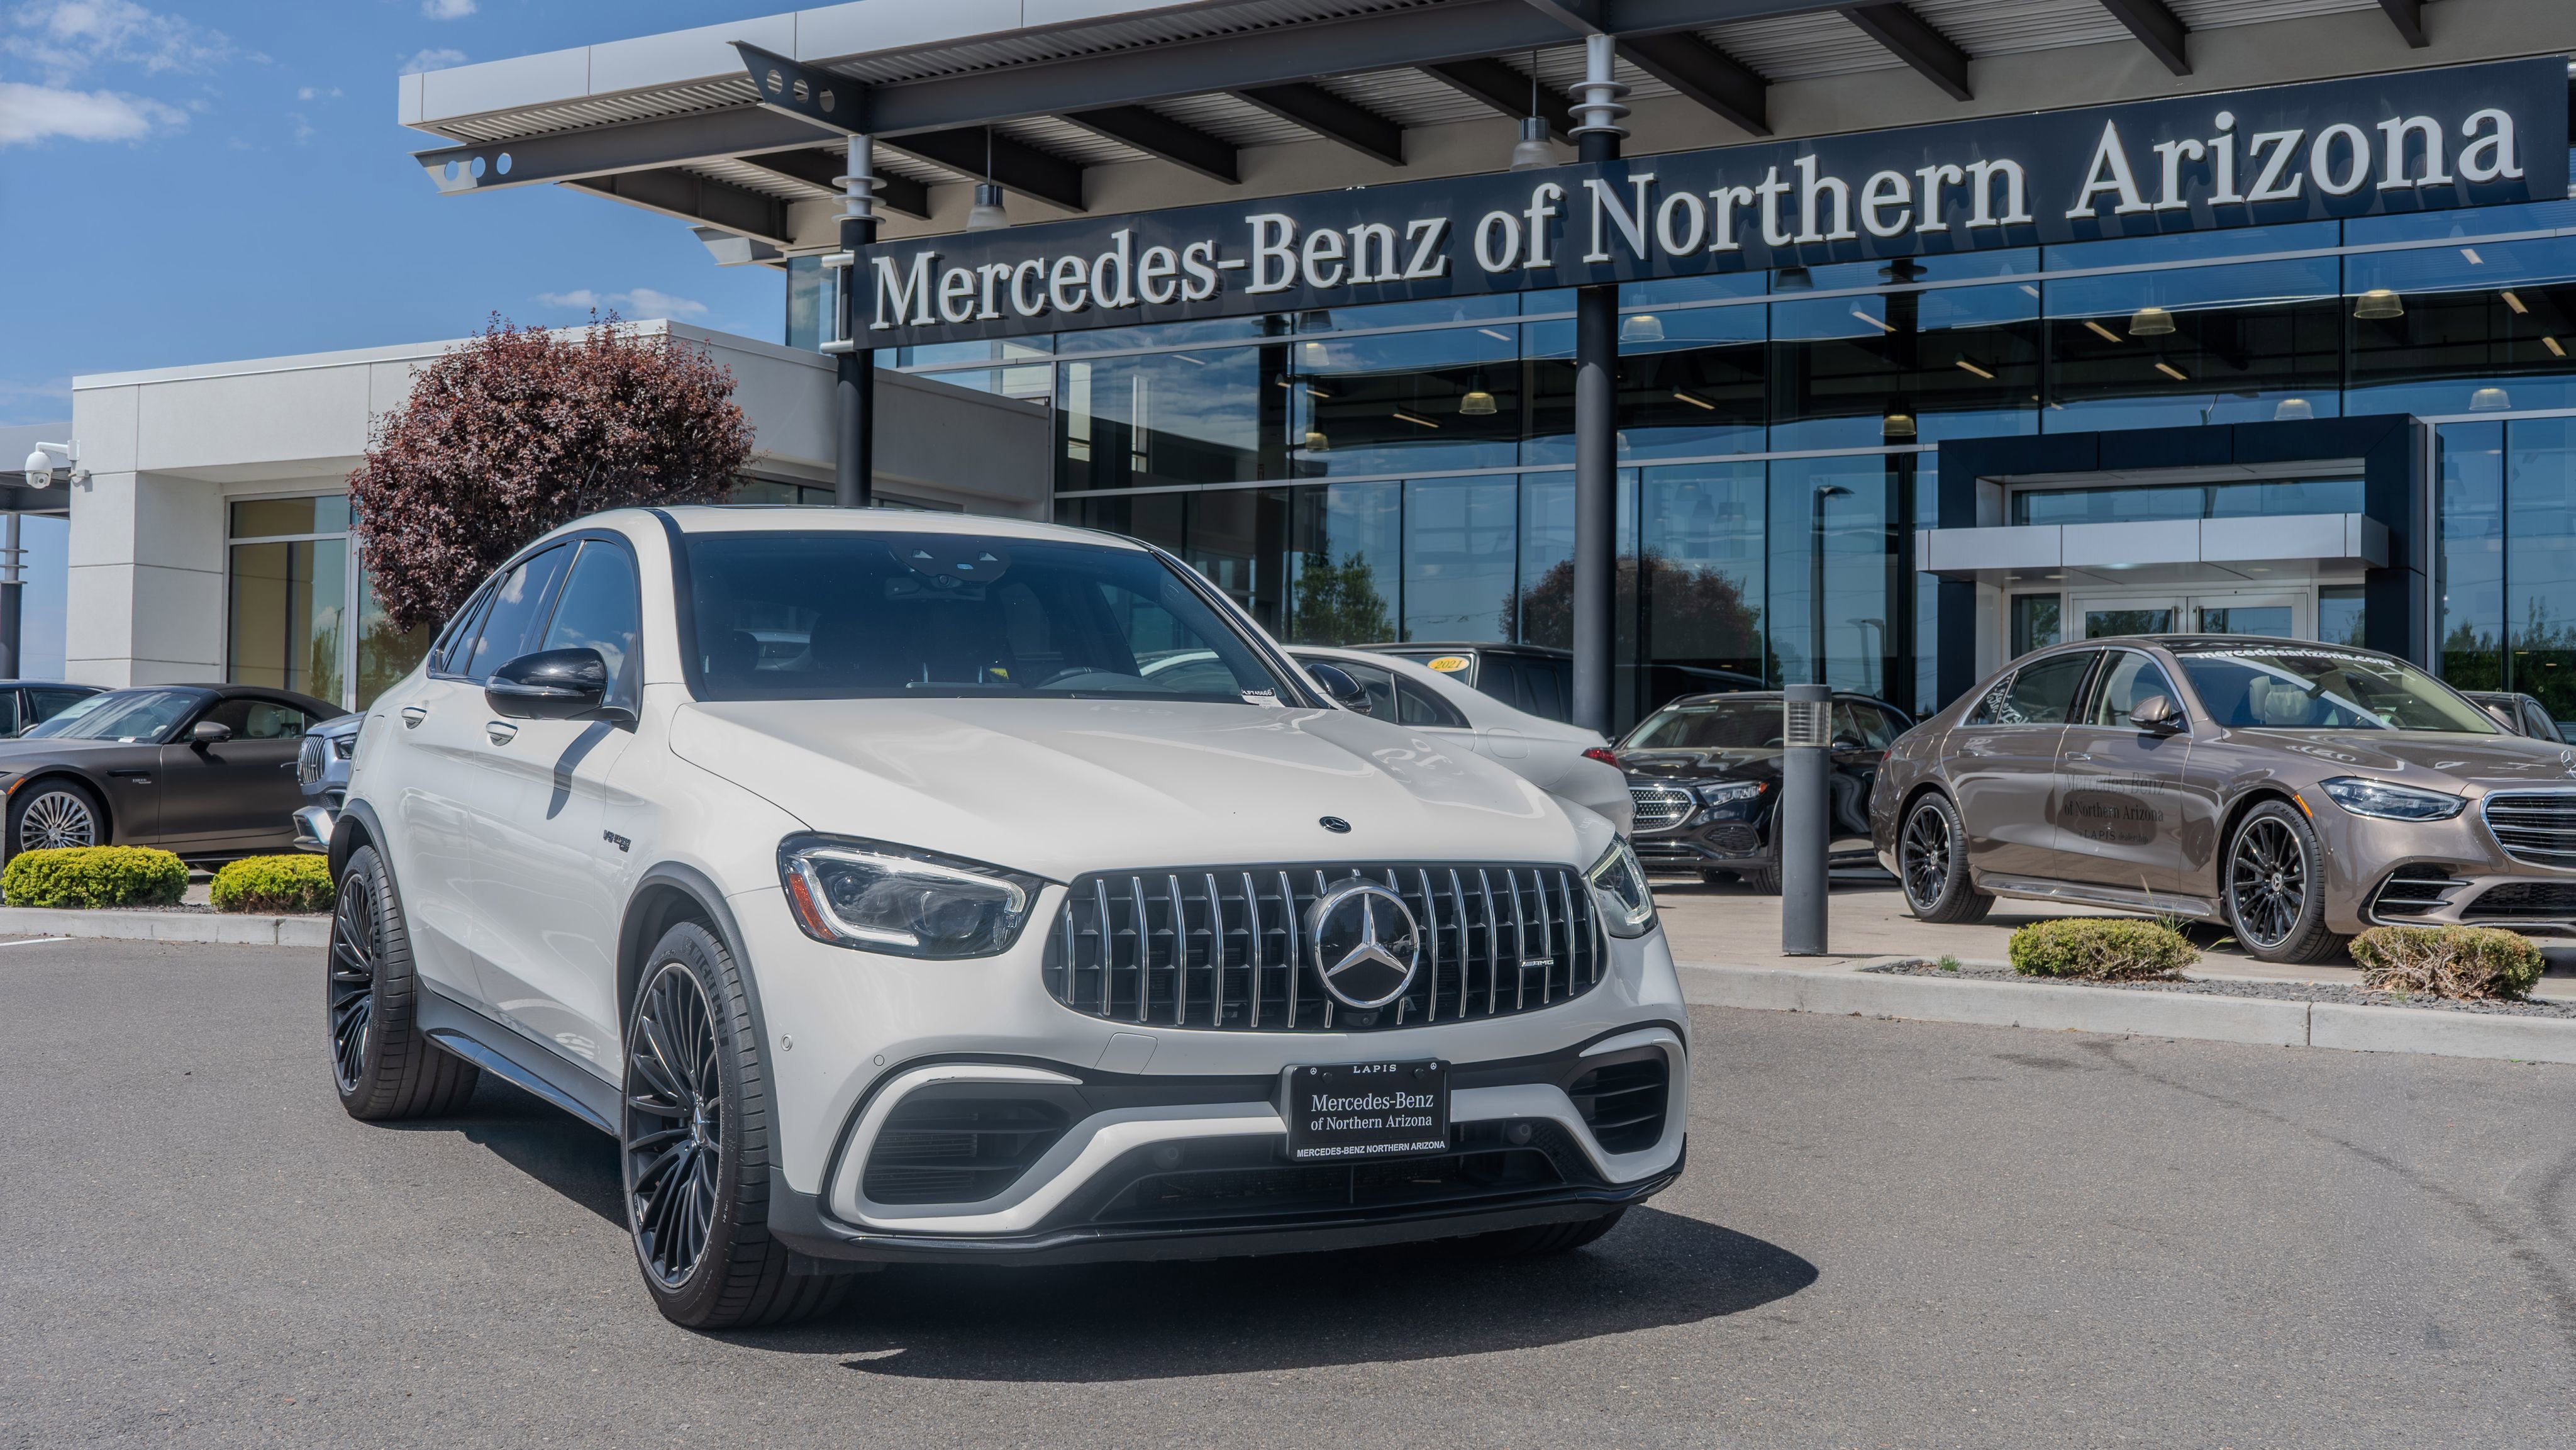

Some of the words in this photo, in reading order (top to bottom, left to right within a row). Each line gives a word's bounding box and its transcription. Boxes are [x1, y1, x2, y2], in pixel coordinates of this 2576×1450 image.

[870, 213, 1448, 330] Mercedes-Benz
[1474, 182, 1564, 273] of
[1582, 154, 2033, 263] Northern
[2065, 108, 2523, 220] Arizona
[1435, 660, 1463, 669] 2021
[2196, 649, 2396, 667] mercedesarizona.com
[2064, 801, 2074, 816] of
[2076, 801, 2119, 819] Northern
[2123, 805, 2164, 822] Arizona
[2084, 829, 2116, 841] LAPIS
[690, 945, 728, 1039] MICHELIN
[1353, 1064, 1397, 1074] LAPIS
[1311, 1091, 1434, 1112] Mercedes-Benz
[1311, 1118, 1323, 1131] of
[1326, 1115, 1382, 1130] Northern
[1385, 1114, 1433, 1128] Arizona
[1297, 1145, 1365, 1157] MERCEDES-BENZ
[1367, 1143, 1409, 1154] NORTHERN
[1411, 1140, 1445, 1151] ARIZONA
